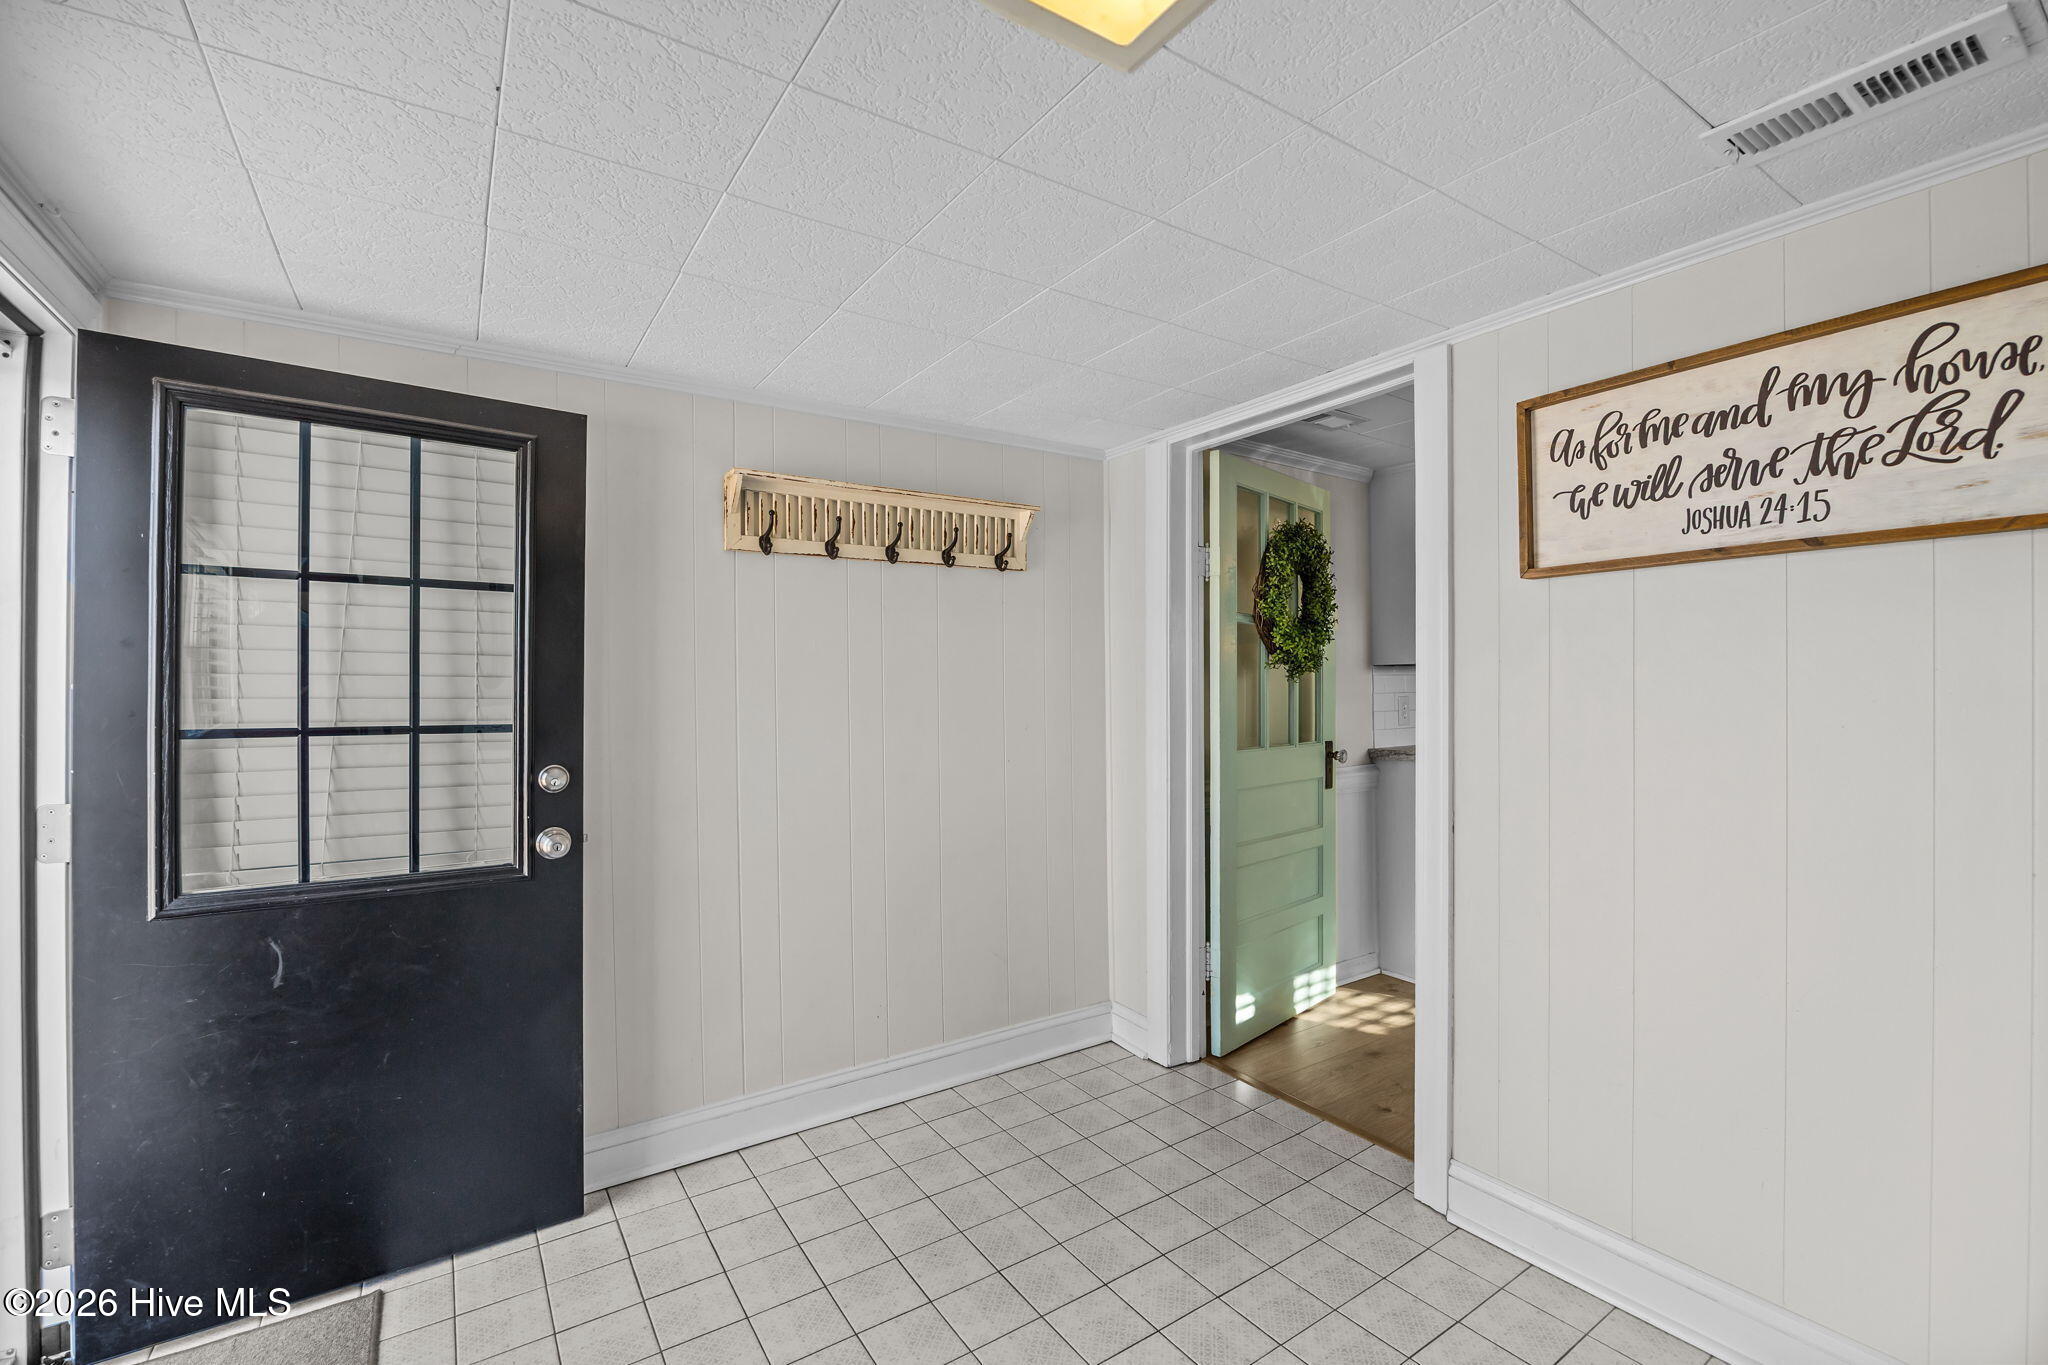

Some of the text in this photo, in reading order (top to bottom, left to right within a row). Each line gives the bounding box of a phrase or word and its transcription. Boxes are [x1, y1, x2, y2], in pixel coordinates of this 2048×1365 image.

[1589, 411, 1634, 471] for
[1633, 407, 1688, 449] me
[1692, 366, 1781, 437] and
[1777, 369, 1886, 419] my
[1893, 321, 2046, 394] house,
[1612, 455, 1684, 509] will
[1688, 446, 1790, 498] serve
[1790, 425, 1885, 485] the
[1881, 389, 2025, 466] Lord.
[1681, 489, 1832, 535] JOSHUA 24:15
